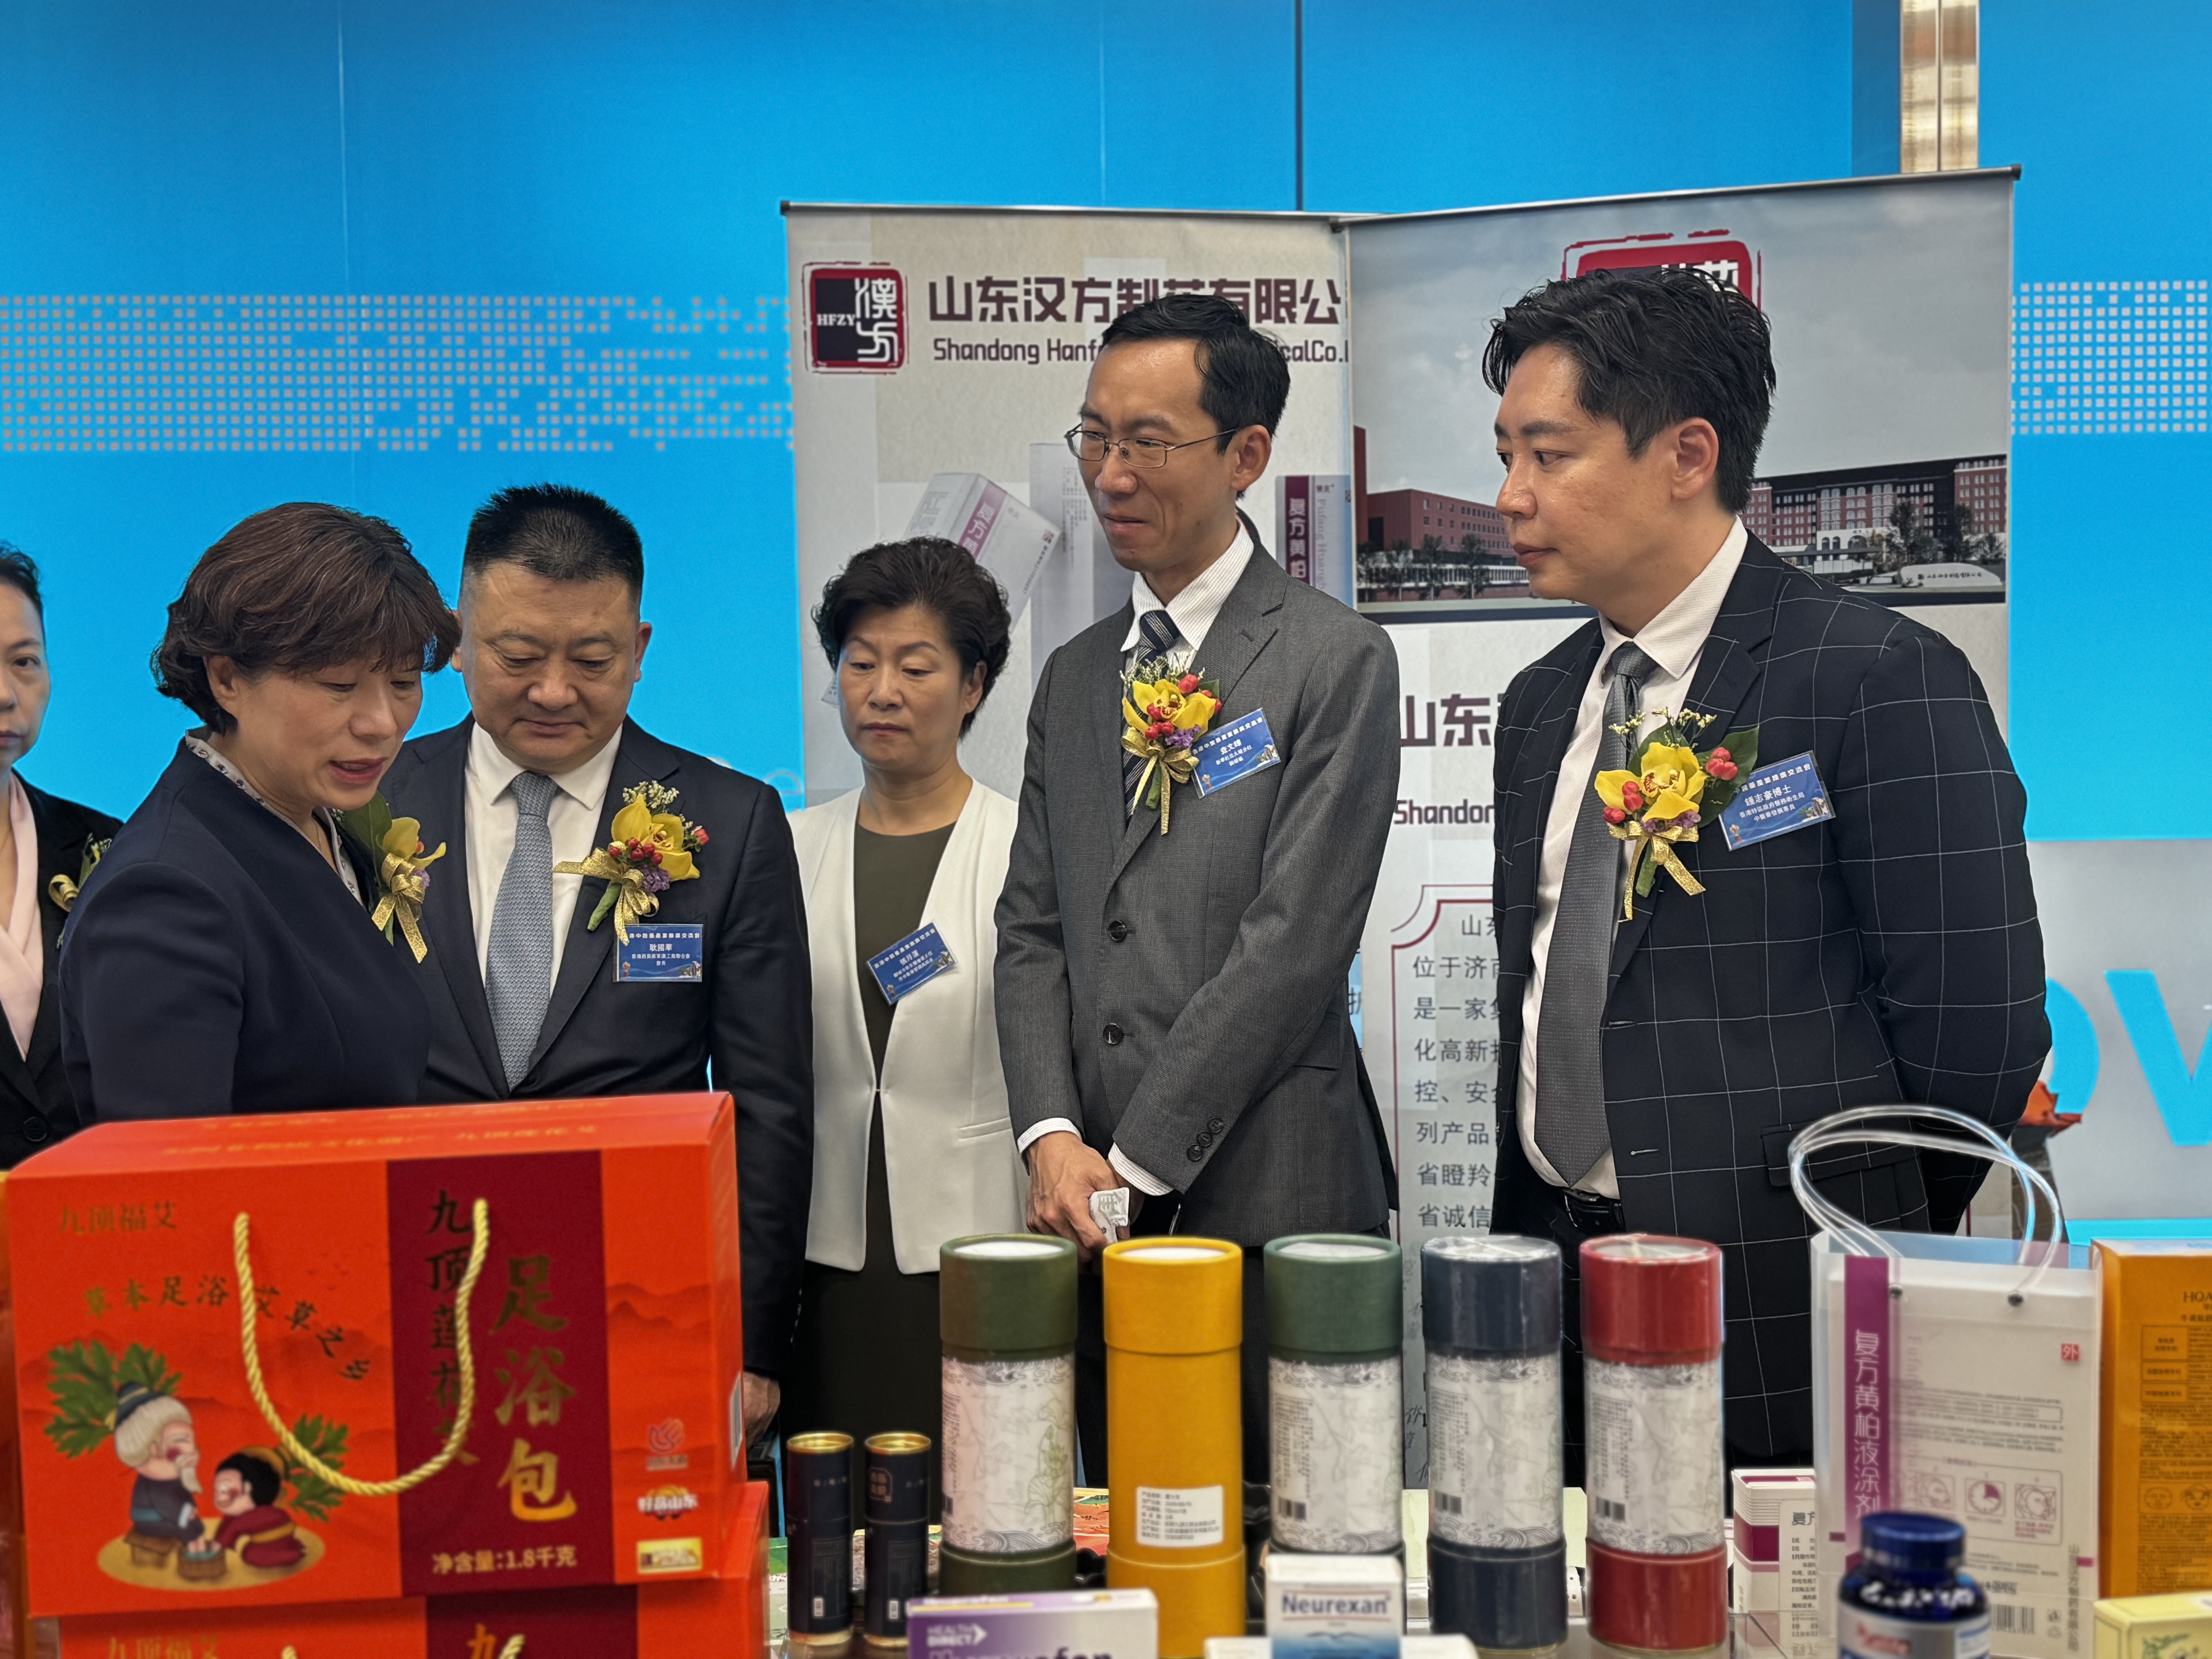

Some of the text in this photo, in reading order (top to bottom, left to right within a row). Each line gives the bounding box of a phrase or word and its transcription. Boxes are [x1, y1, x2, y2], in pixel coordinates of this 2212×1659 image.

[817, 314, 854, 326] HFZY
[934, 338, 1040, 364] Shandong
[1047, 339, 1102, 361] Hanf
[1417, 1163, 1491, 1187] 省瞪羚
[1418, 1204, 1492, 1228] 省诚信
[2063, 1345, 2078, 1360] 外
[489, 1253, 578, 1522] 足浴包
[1854, 1329, 1881, 1520] 复方黄柏液涂剂
[433, 1546, 577, 1575] 净含量:1.8千克
[1282, 1594, 1388, 1614] Neurexan
